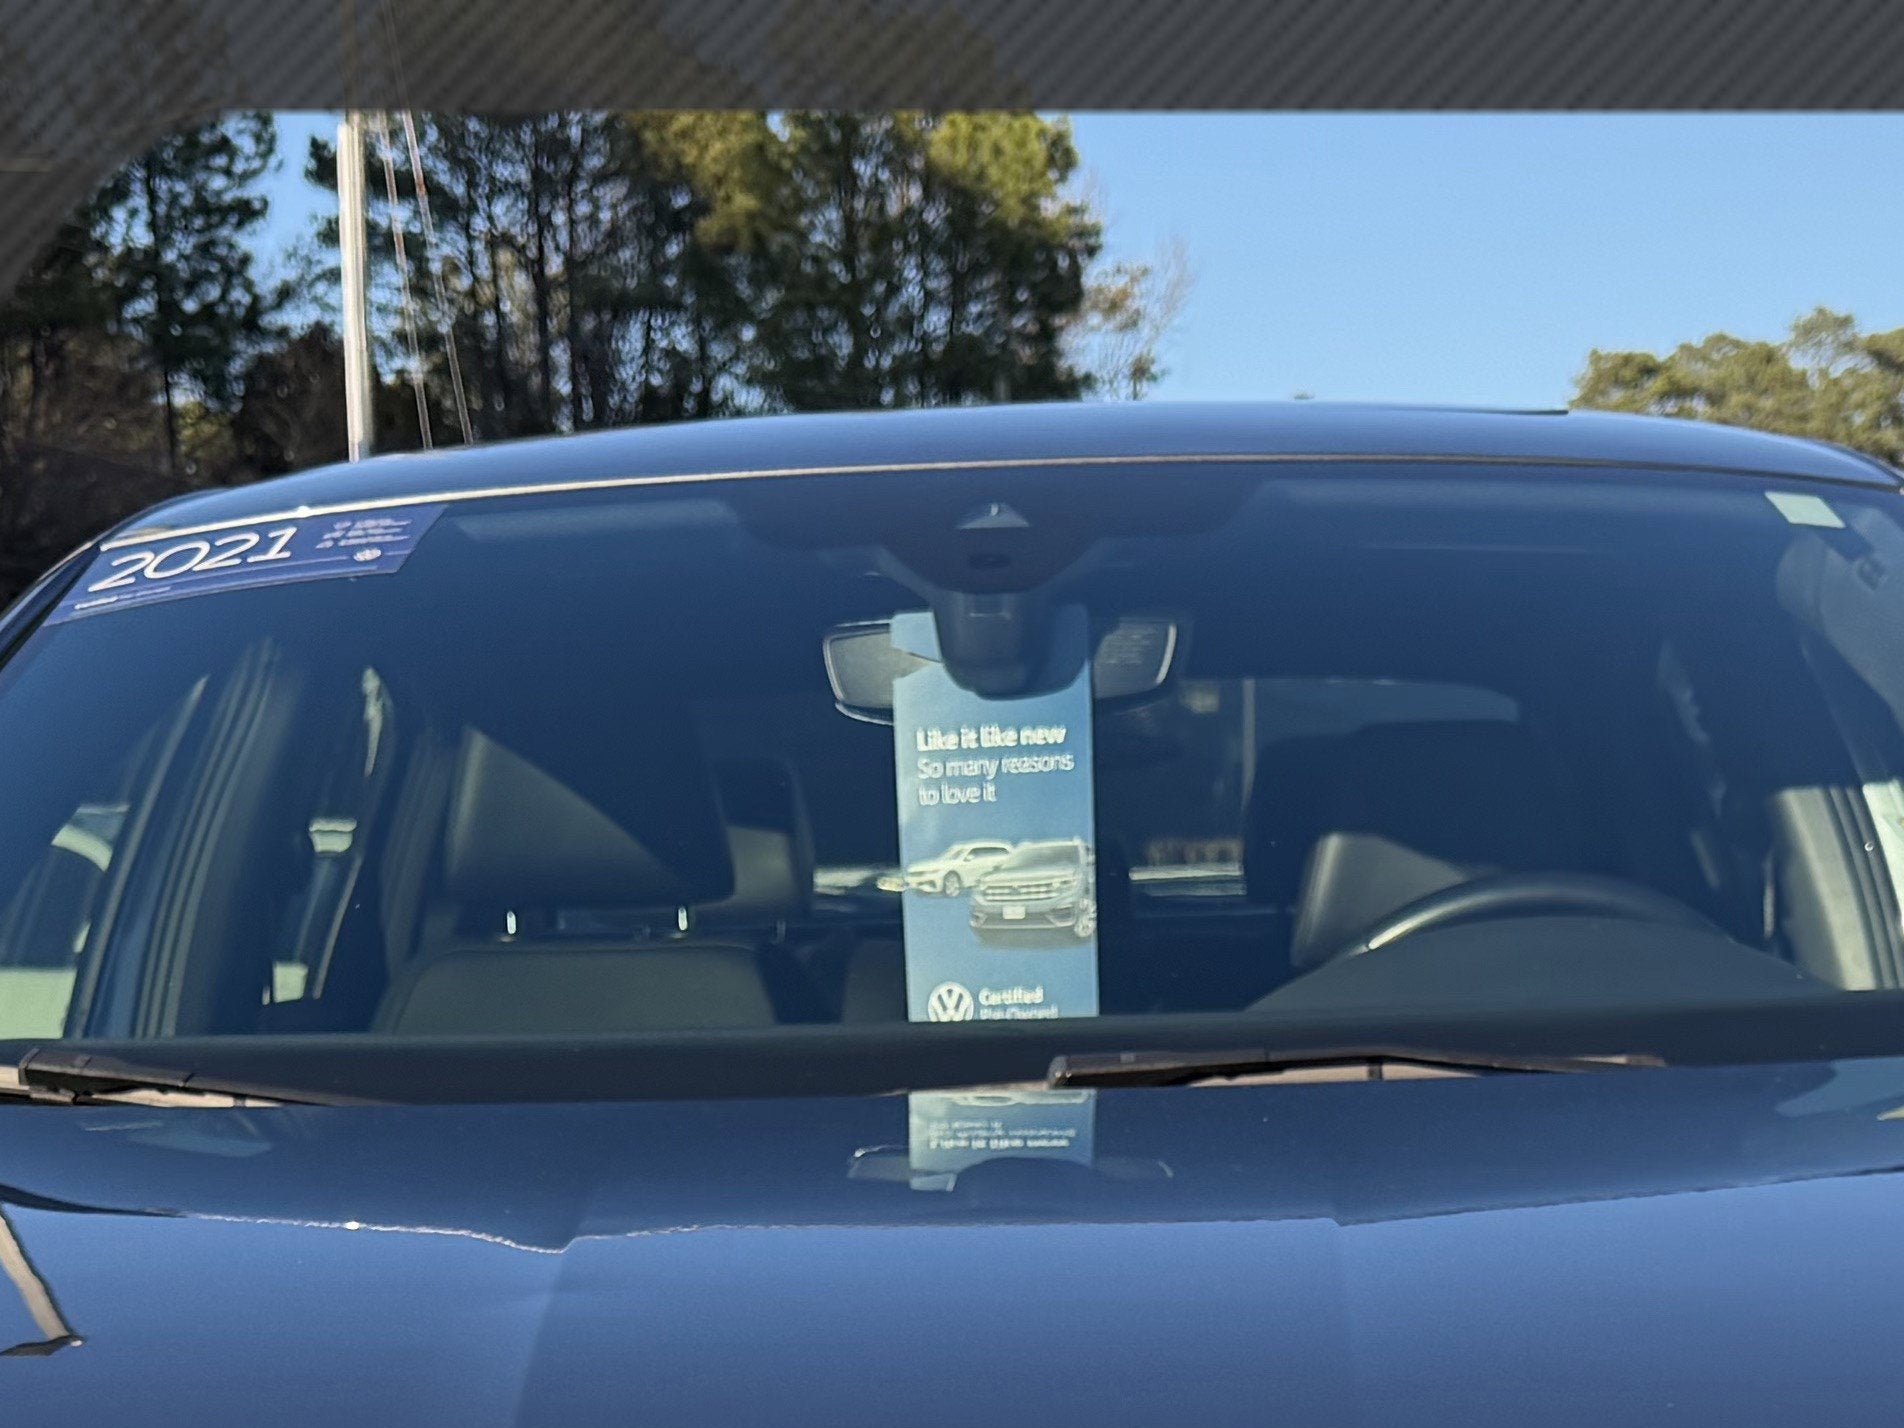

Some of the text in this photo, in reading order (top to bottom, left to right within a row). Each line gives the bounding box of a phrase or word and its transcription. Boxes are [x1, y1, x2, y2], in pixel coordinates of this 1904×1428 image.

[87, 526, 298, 593] 2021
[916, 723, 1066, 751] Like it like new
[917, 754, 1075, 780] So many reasons
[918, 780, 996, 805] to love it
